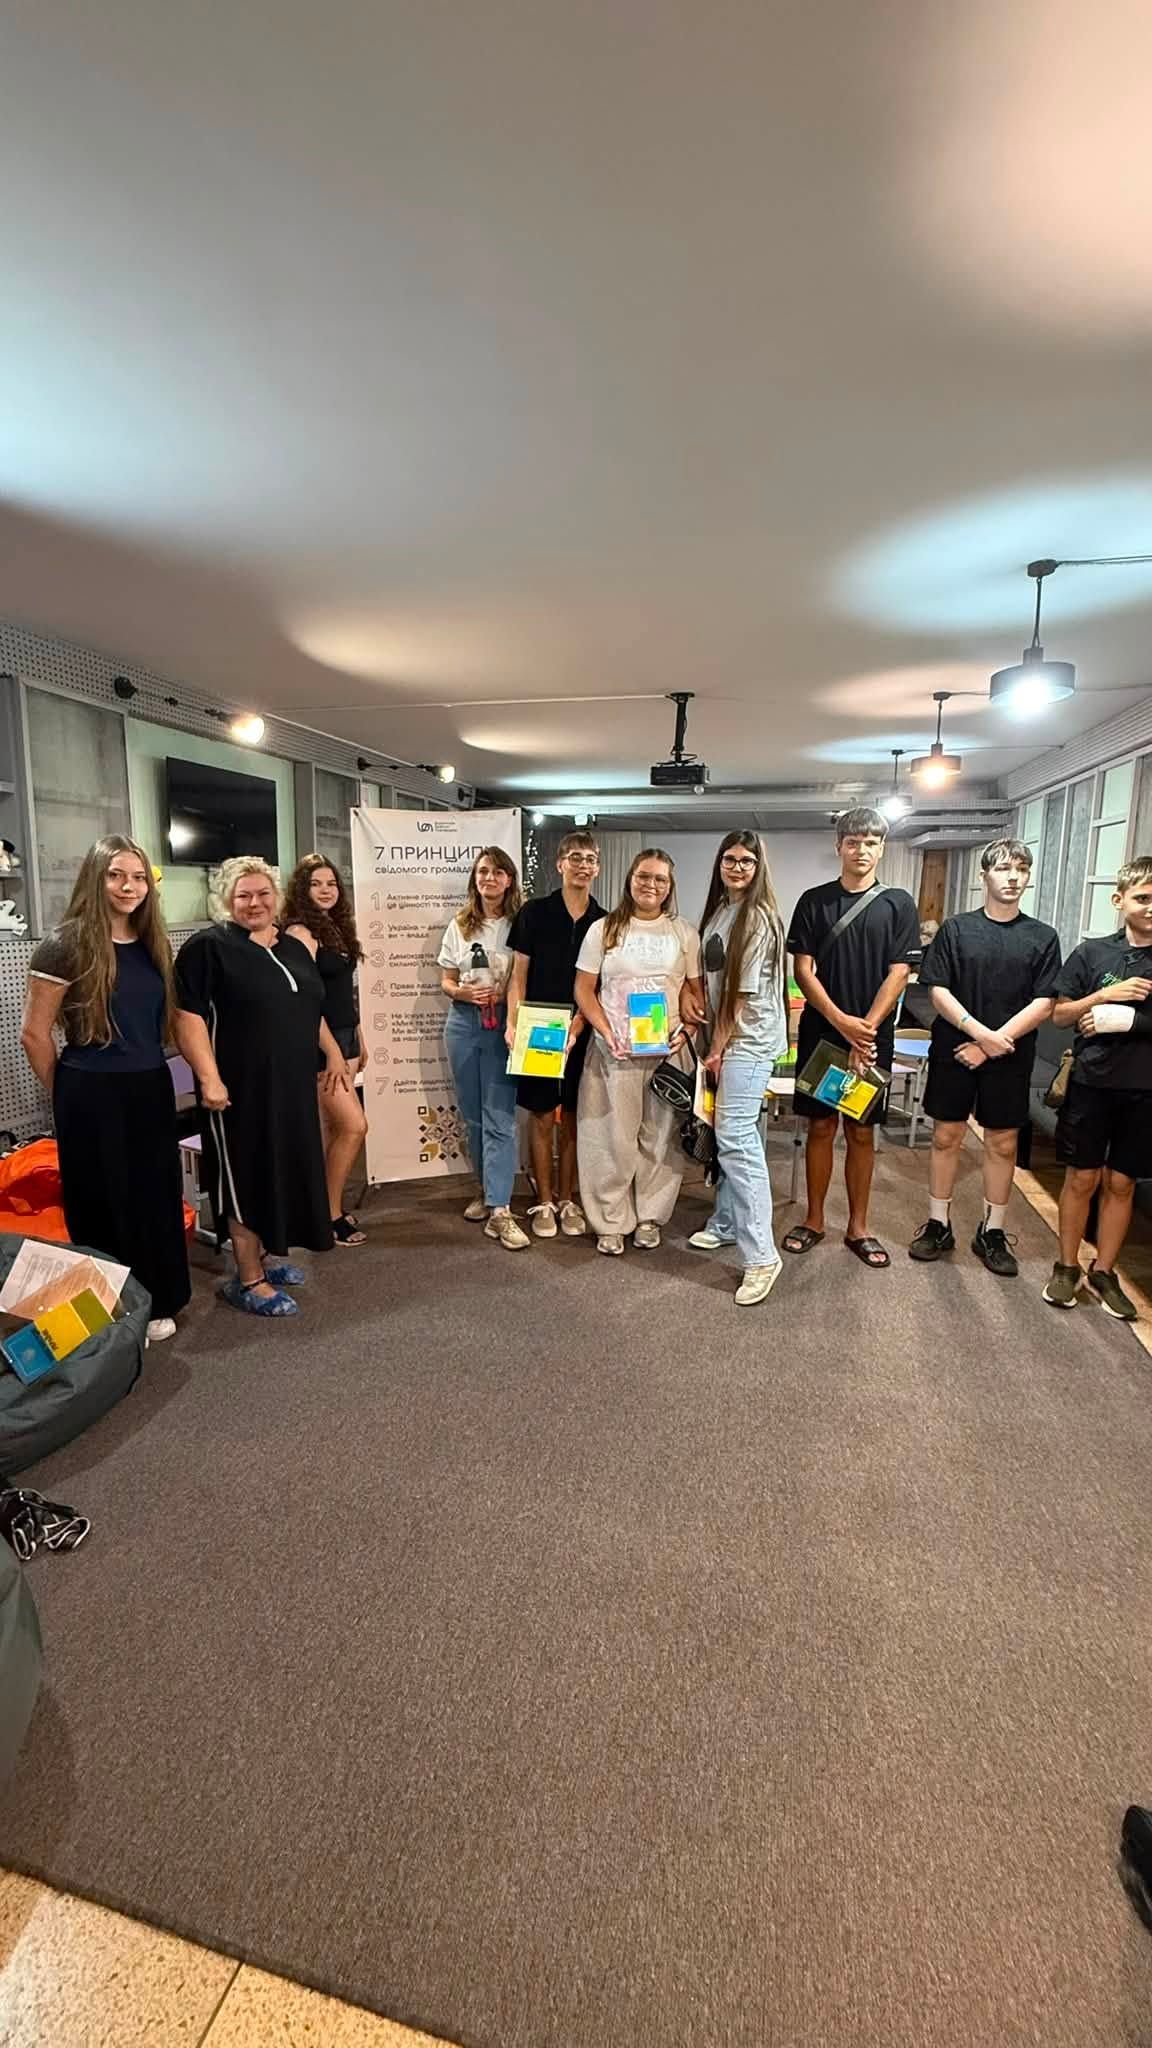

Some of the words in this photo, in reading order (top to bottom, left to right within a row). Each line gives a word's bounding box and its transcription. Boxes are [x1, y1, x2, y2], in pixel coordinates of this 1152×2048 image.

[374, 846, 385, 861] 7
[391, 846, 485, 863] ПРИНЦИП
[374, 864, 428, 874] свідомого
[430, 865, 473, 875] громадя
[370, 891, 381, 911] 1
[369, 920, 385, 940] 2
[369, 949, 385, 968] 3
[370, 979, 388, 998] 4
[374, 1012, 389, 1032] 5
[373, 1046, 390, 1065] 6
[375, 1076, 391, 1096] 7
